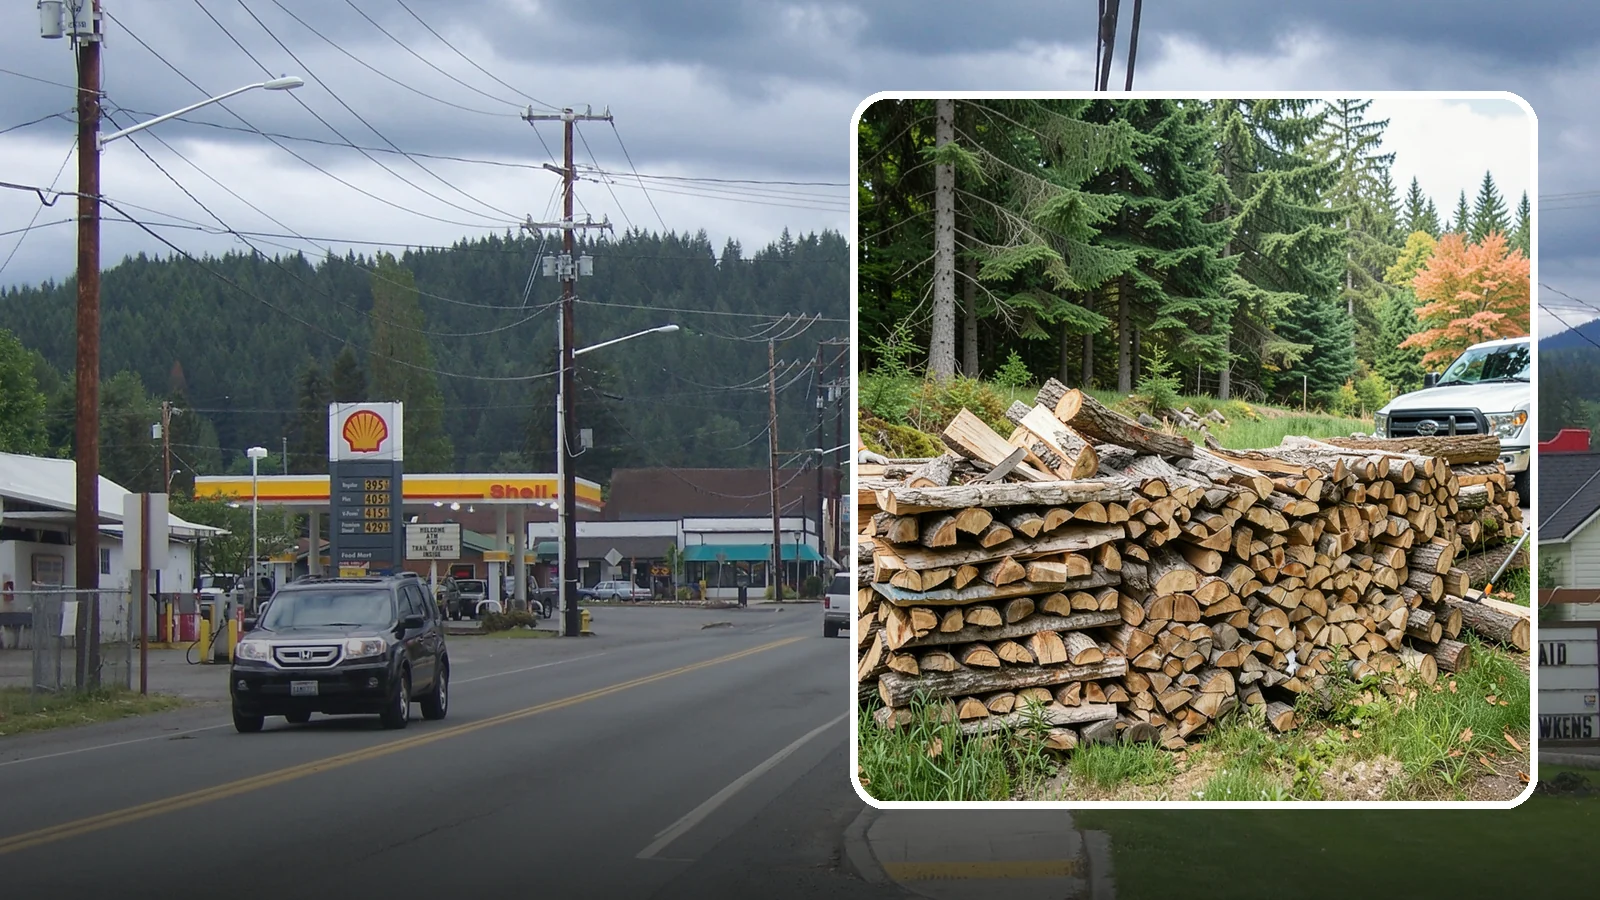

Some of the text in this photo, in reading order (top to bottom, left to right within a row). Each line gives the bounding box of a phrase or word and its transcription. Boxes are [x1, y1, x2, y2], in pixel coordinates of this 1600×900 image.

[365, 480, 384, 490] 395
[490, 484, 547, 499] Shell
[365, 494, 384, 504] 405
[365, 508, 384, 518] 415
[365, 522, 384, 532] 429
